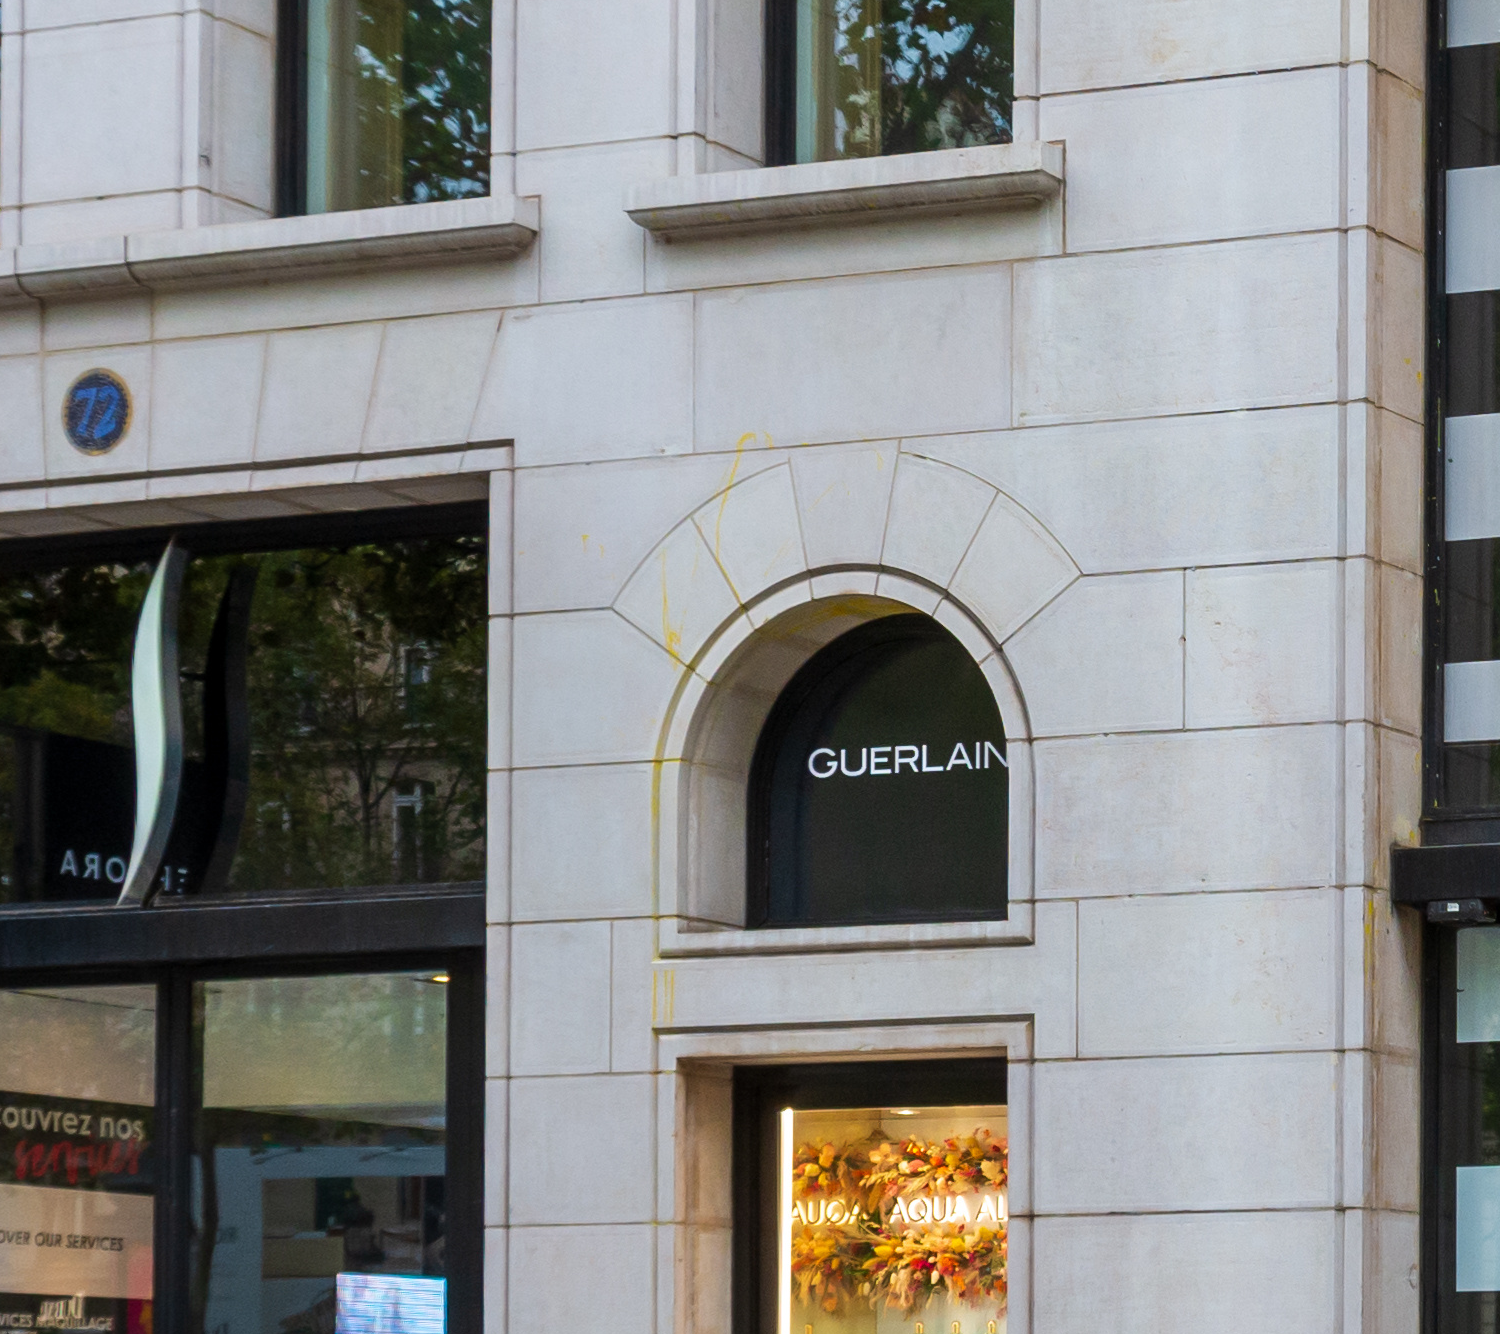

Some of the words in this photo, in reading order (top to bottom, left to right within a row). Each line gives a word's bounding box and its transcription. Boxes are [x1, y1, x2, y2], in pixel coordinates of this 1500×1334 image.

[74, 385, 120, 439] 72
[808, 741, 1008, 779] GUERLAIN
[100, 1116, 144, 1141] nos
[889, 1194, 970, 1224] AQUA
[35, 1231, 62, 1248] OUR
[66, 1234, 124, 1252] SERVICES
